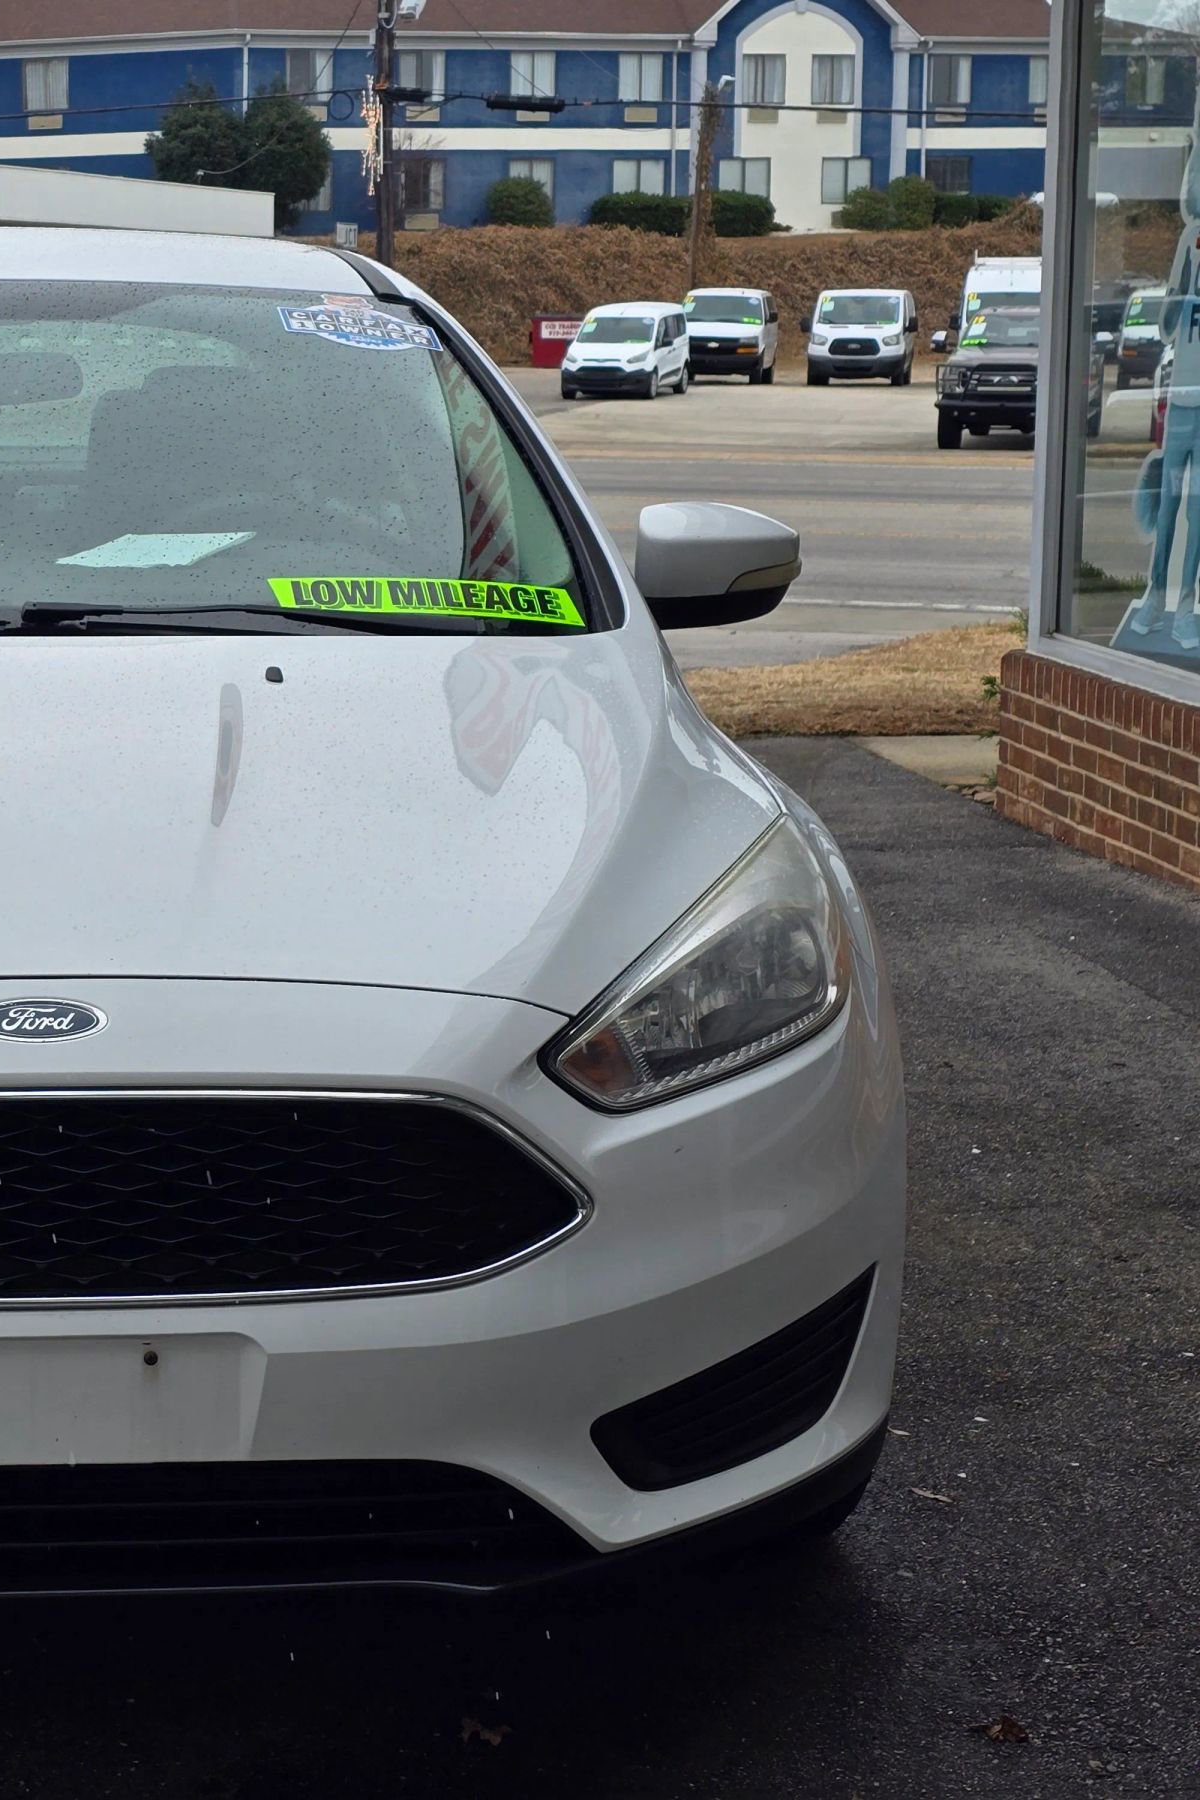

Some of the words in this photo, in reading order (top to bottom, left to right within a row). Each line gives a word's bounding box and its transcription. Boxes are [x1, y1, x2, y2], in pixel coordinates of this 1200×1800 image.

[292, 310, 428, 337] CARFAX
[319, 322, 430, 346] OWNER
[290, 580, 378, 607] LOW
[386, 580, 564, 618] MILEAGE
[1, 1007, 76, 1031] Ford
